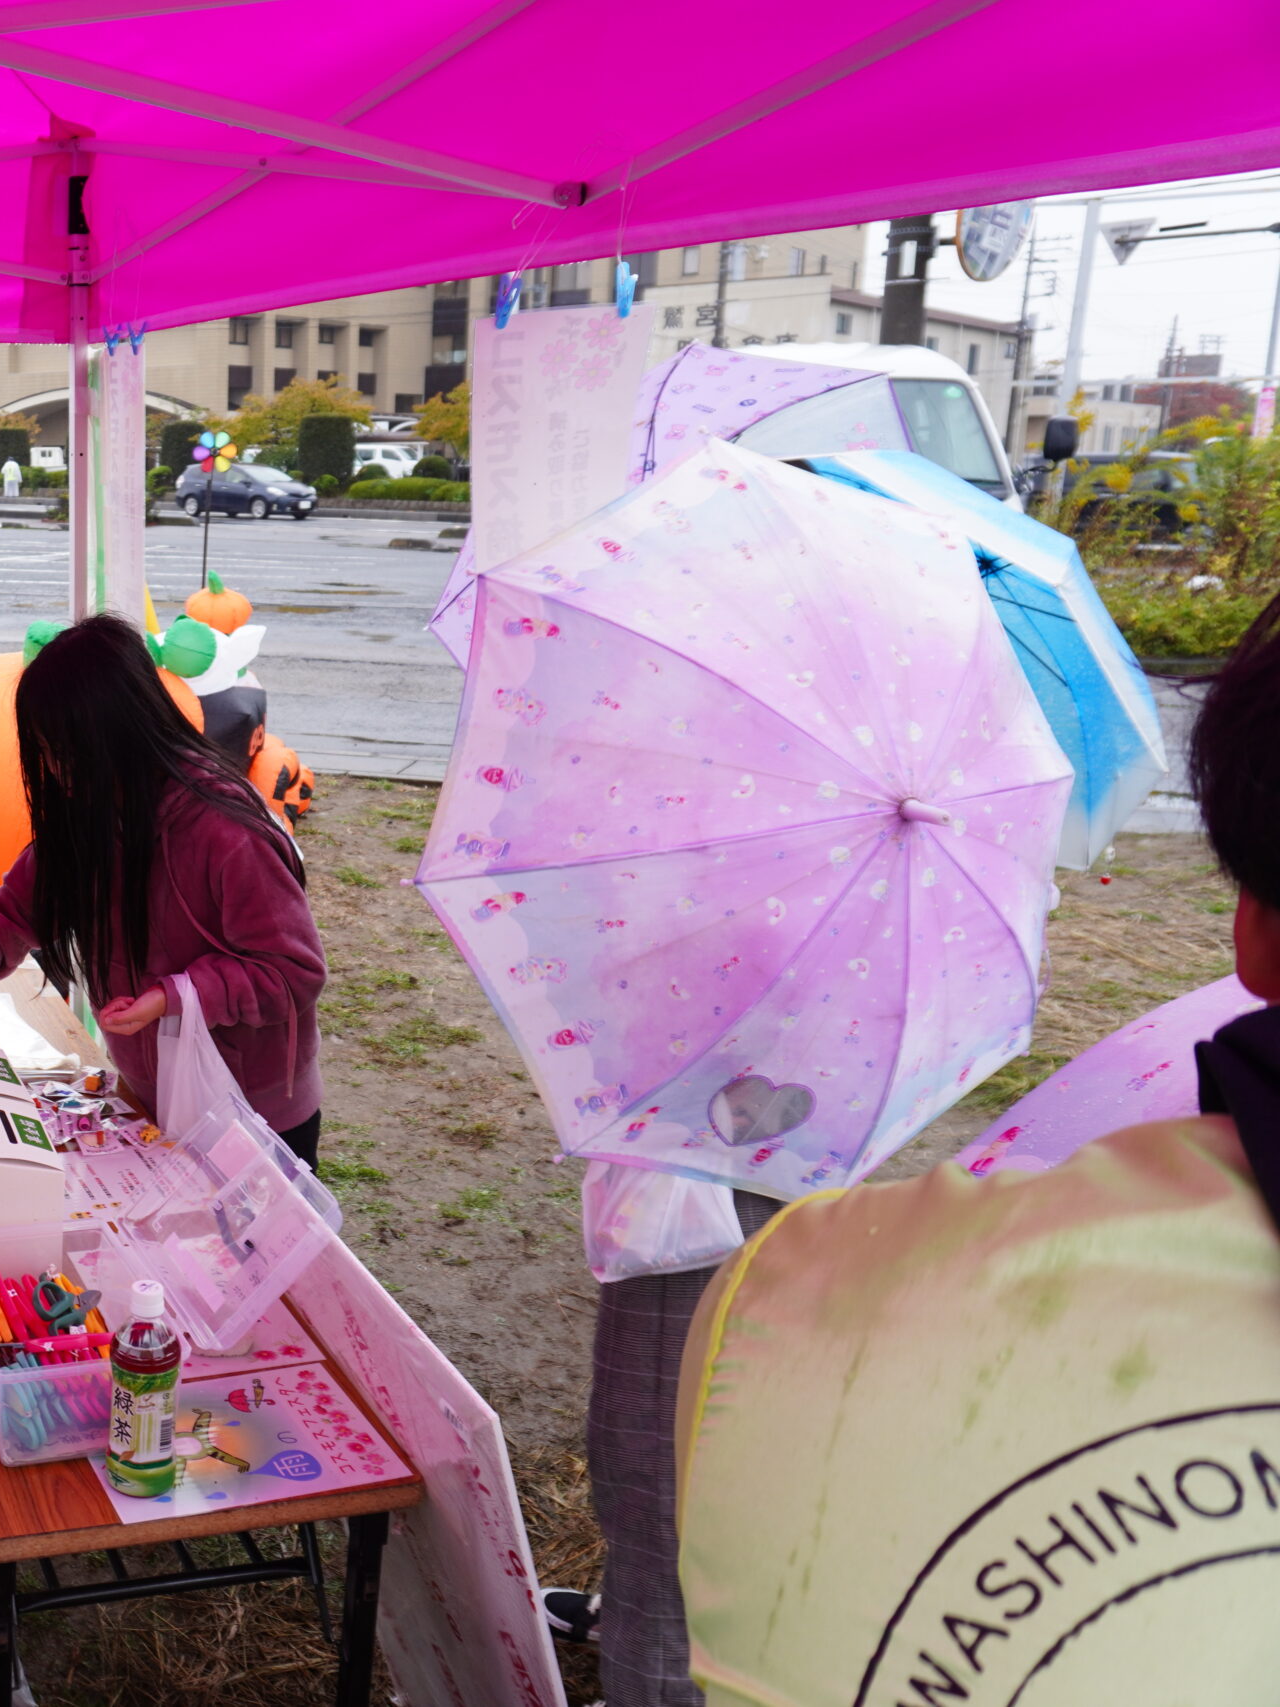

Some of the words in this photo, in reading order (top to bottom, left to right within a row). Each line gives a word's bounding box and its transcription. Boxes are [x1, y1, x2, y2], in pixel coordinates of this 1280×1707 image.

[113, 1387, 134, 1446] 緑茶
[275, 1376, 357, 1475] コスモスフェスタへ
